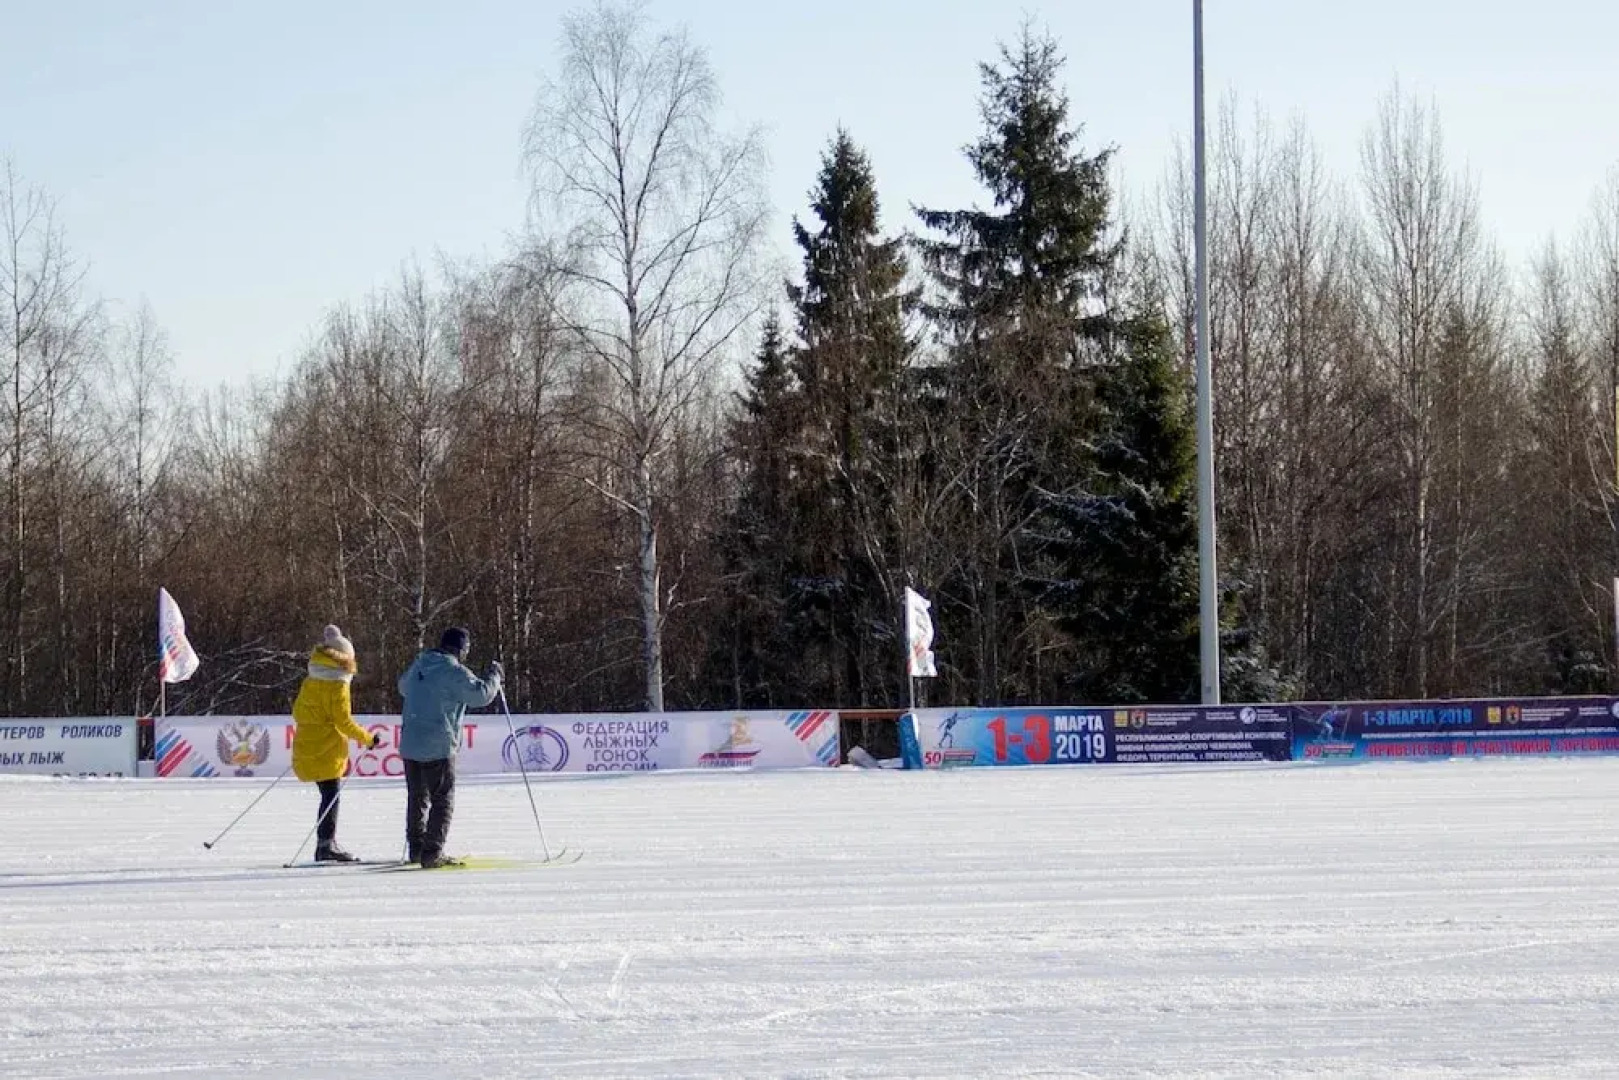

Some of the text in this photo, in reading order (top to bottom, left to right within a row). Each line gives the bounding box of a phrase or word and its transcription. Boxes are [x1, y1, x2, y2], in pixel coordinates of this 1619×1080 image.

[1054, 715, 1104, 732] МАРТА
[1362, 708, 1473, 726] 1-3 МАРТА 2019
[0, 725, 122, 739] ТЕРОВ РОЛИКОВ
[572, 721, 669, 736] ФЕДЕРАЦИЯ
[583, 735, 659, 749] ЛЫЖНЫХ
[987, 714, 1050, 763] 1-3
[1056, 733, 1106, 759] 2019
[0, 751, 65, 765] ЫХ ЛЫЖ
[594, 750, 650, 762] ГОНОК
[923, 751, 942, 765] 50
